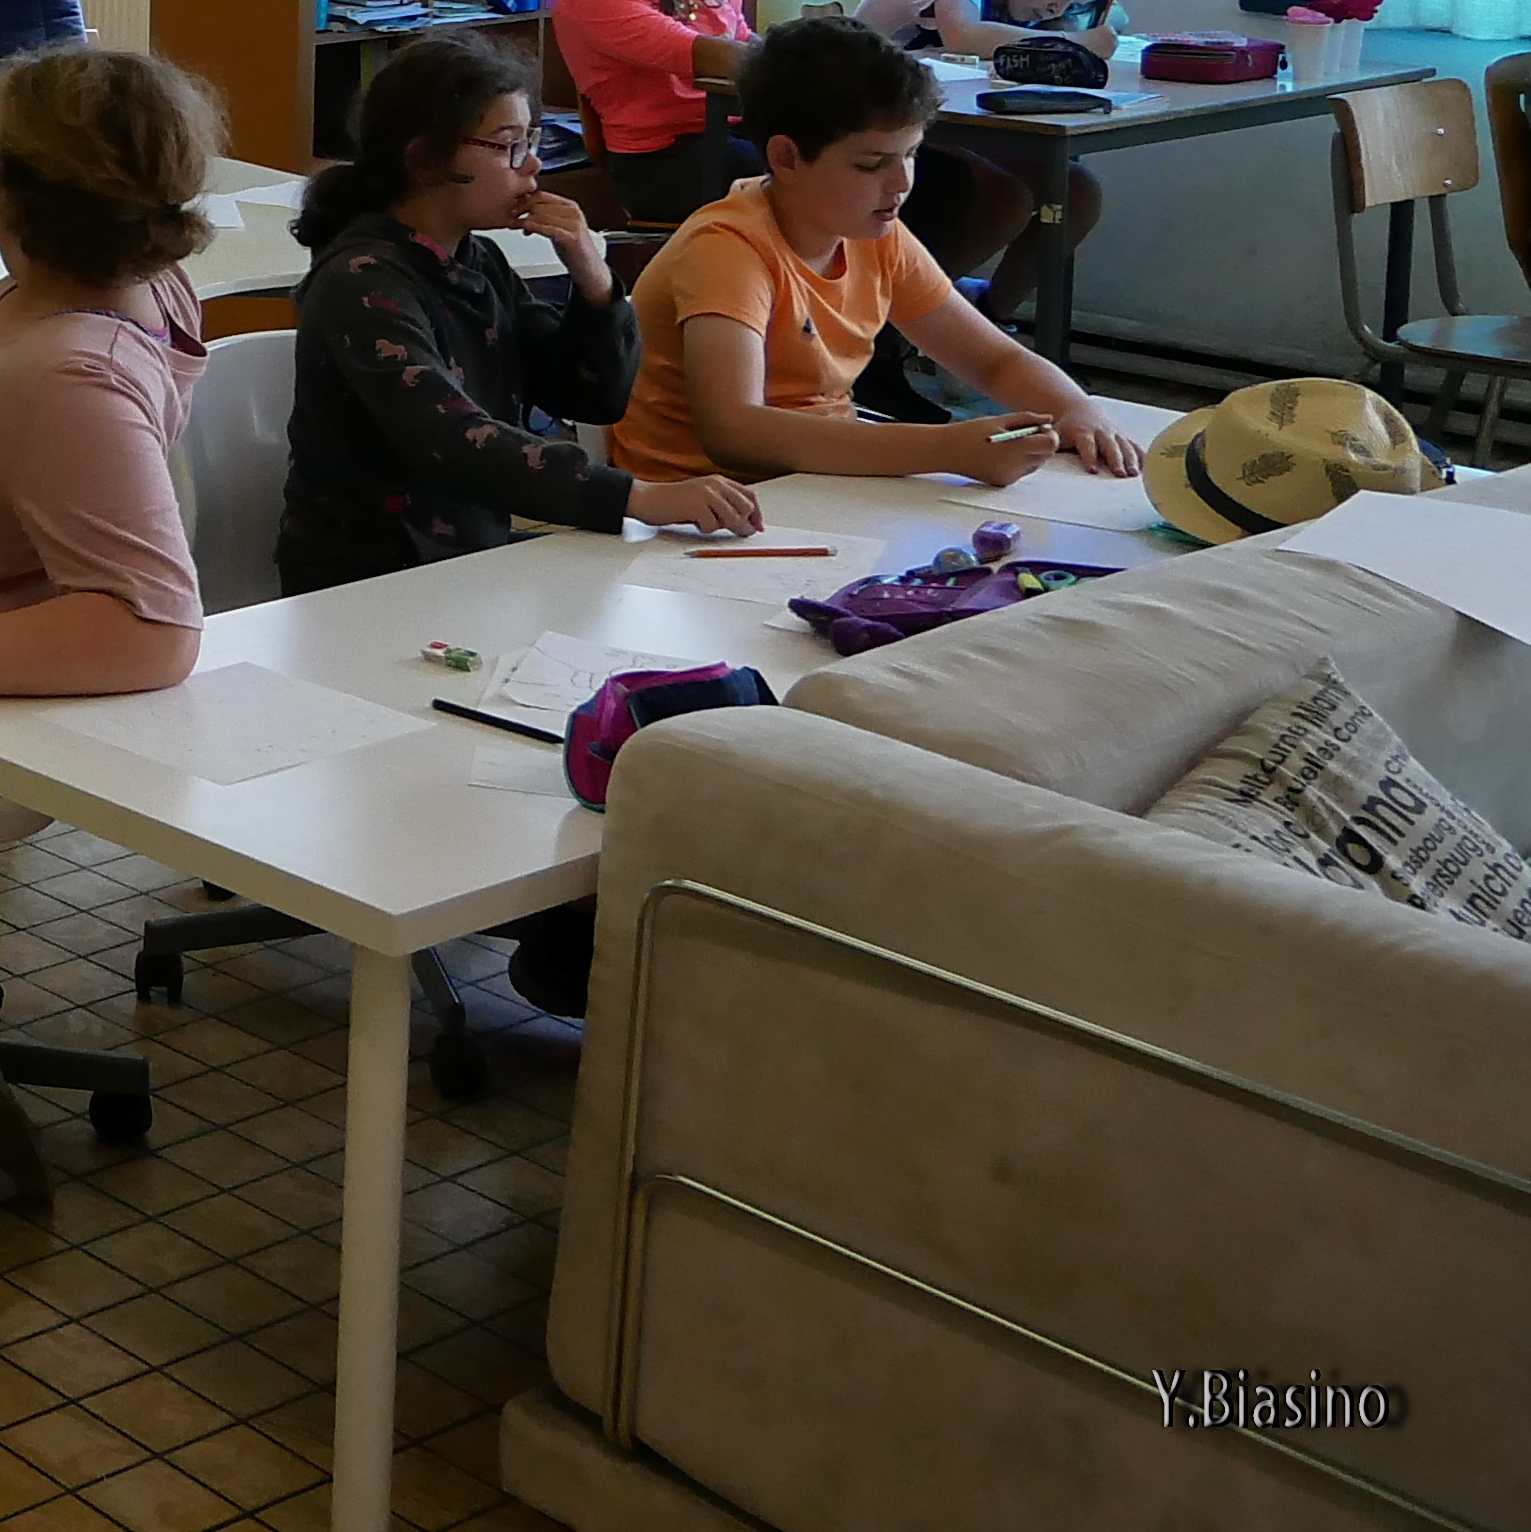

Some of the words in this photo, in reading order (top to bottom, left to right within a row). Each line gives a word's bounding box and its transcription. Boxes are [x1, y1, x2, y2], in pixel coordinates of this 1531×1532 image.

[1273, 739, 1342, 812] Bruelles
[1390, 817, 1458, 887] Sasbourg
[1406, 834, 1484, 912] Persburg
